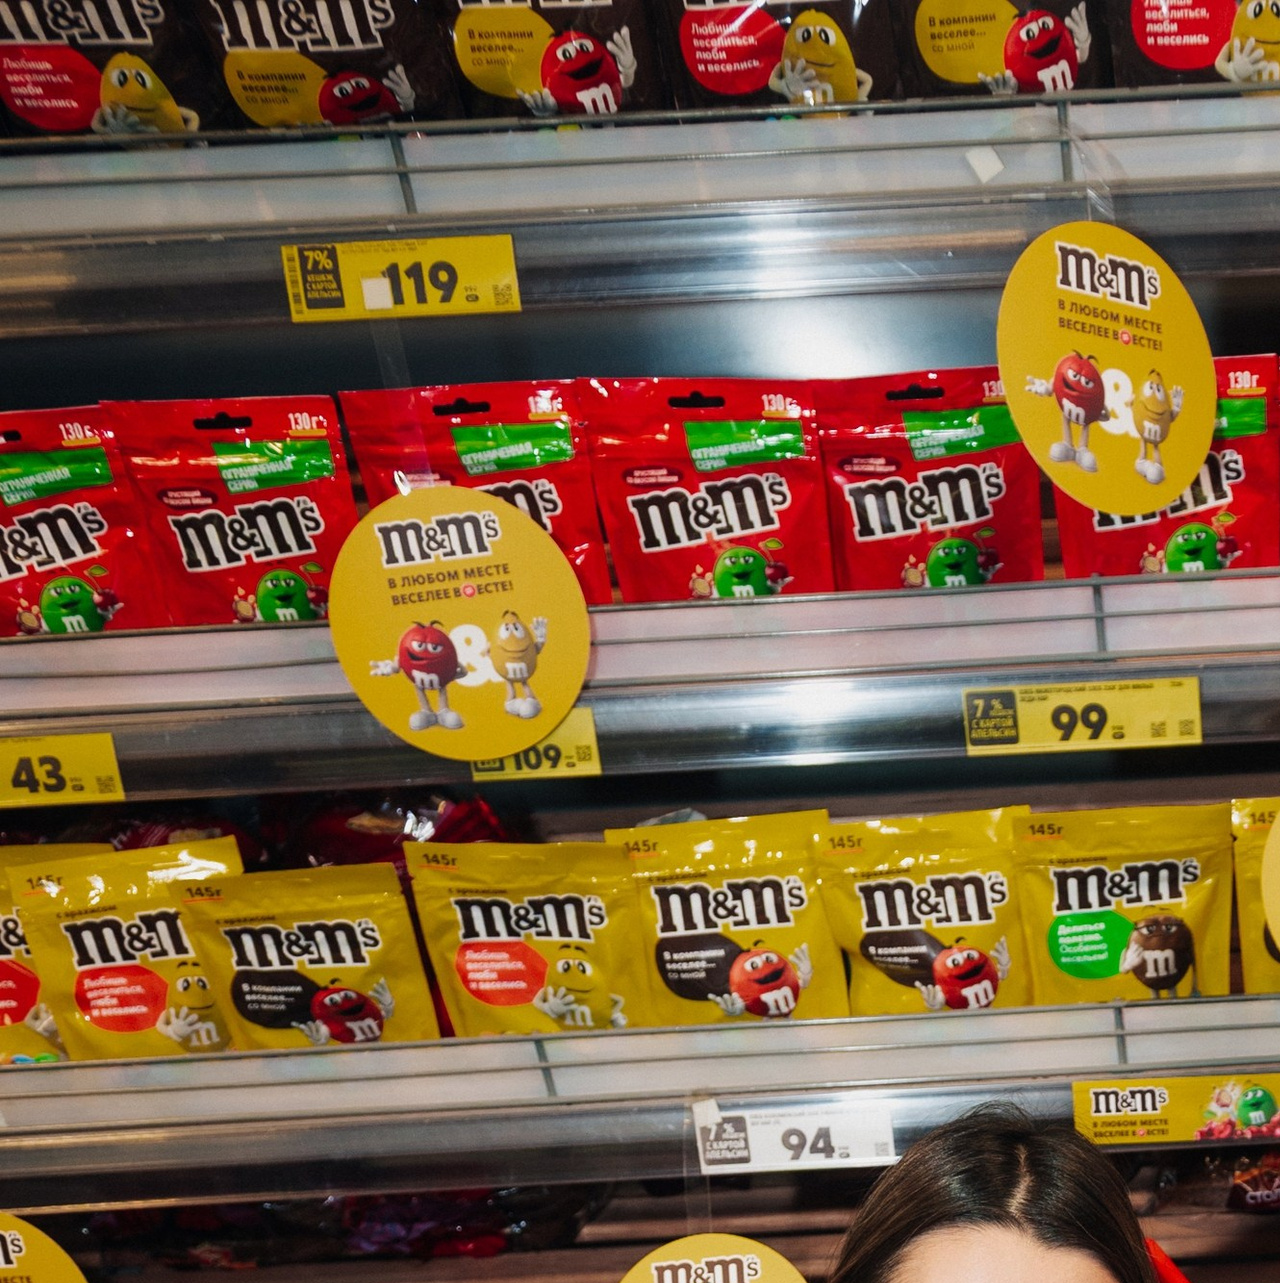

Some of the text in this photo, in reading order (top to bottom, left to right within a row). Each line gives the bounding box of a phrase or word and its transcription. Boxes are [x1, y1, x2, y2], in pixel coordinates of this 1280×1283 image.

[928, 12, 997, 27] В компании
[1146, 22, 1179, 34] люби
[468, 28, 534, 40] В компании
[1155, 34, 1210, 46] веселись
[695, 48, 727, 61] люби
[931, 41, 975, 53] со мной
[303, 250, 334, 270] 7%
[382, 260, 459, 306] 119
[1056, 243, 1160, 308] m&m's
[1058, 299, 1163, 334] В ЛЮБОМ МЕСТЕ
[1059, 317, 1110, 339] ВЕСЕЛЕЕ
[1227, 369, 1260, 389] 130г
[287, 412, 324, 431] 130г
[460, 441, 533, 466] ОГРАНИЧЕННАЯ
[221, 457, 296, 482] ОГРАНИЧЕННАЯ
[629, 472, 790, 551] m&m's
[845, 462, 1005, 541] m&m's
[171, 496, 324, 571] m&m's
[376, 513, 500, 566] m&m's
[387, 563, 511, 589] В ЛЮБОМ МЕСТЕ
[391, 591, 451, 607] ВЕСЕЛЕЕ
[1051, 702, 1108, 742] 99
[513, 743, 562, 772] 109
[10, 755, 67, 794] 43
[828, 835, 862, 849] 145г
[1028, 823, 1064, 836] 145г
[623, 840, 660, 854] 145г
[422, 853, 458, 867] 145г
[186, 885, 222, 899] 145г
[1052, 858, 1199, 914] m&m's
[652, 877, 807, 934] m&m's
[857, 871, 1008, 929] m&m's
[453, 894, 607, 940] m&m's
[222, 919, 381, 968] m&m's
[781, 1126, 835, 1160] 94
